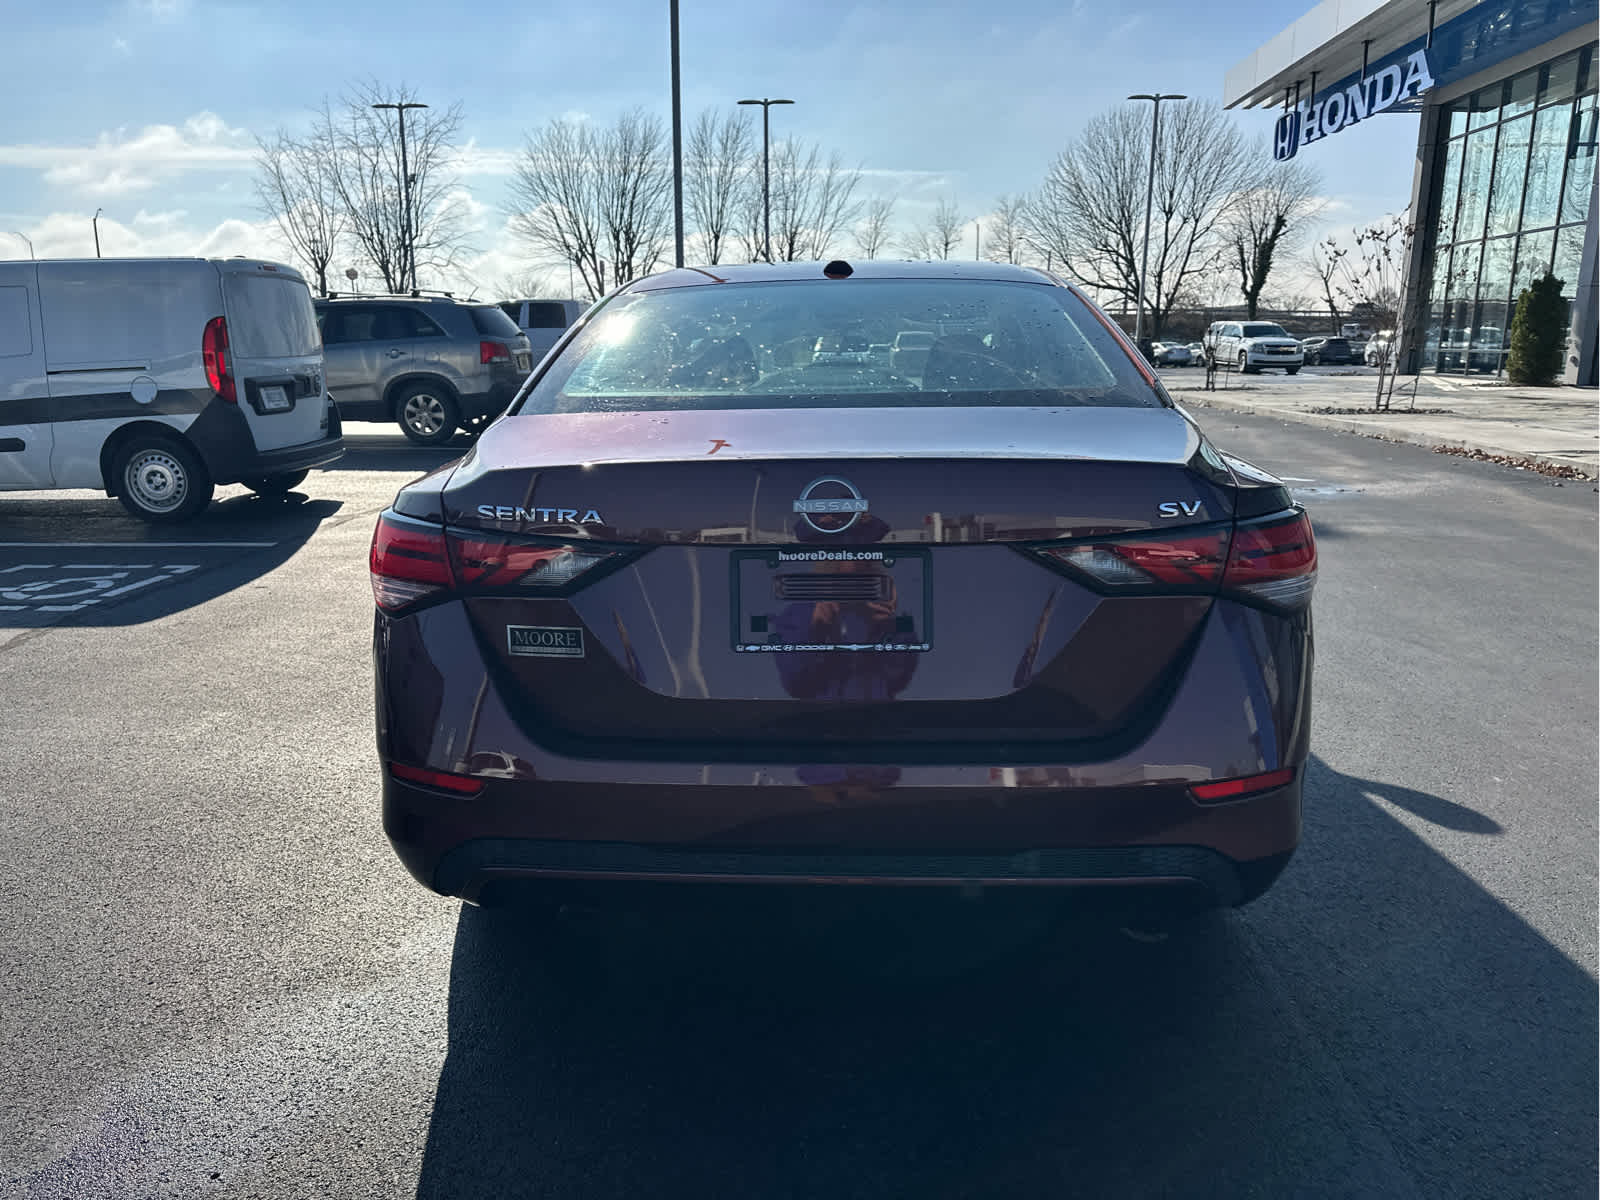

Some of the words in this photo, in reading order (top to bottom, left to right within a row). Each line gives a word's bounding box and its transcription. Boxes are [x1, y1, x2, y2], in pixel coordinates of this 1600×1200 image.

[1298, 48, 1435, 146] HONDA
[477, 504, 605, 526] SENTRA
[795, 501, 866, 511] NISSAN
[1159, 500, 1202, 518] SV
[511, 630, 577, 647] MOORE
